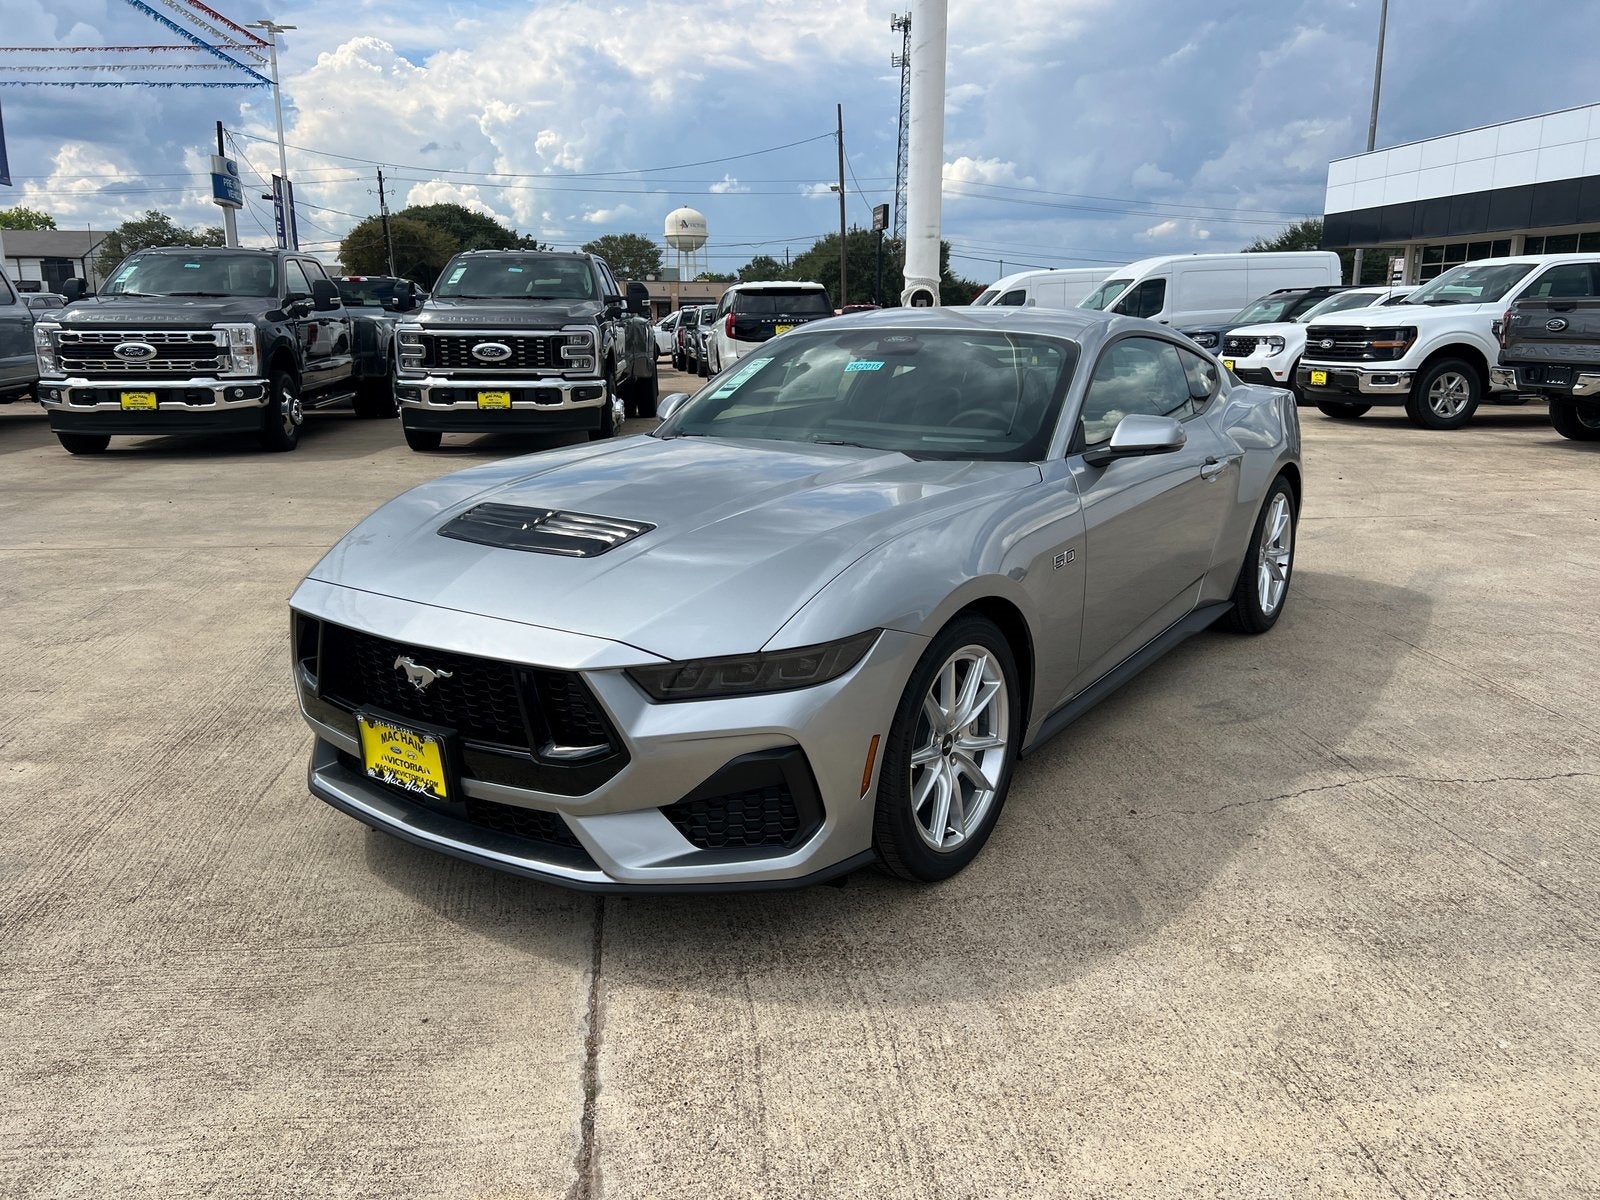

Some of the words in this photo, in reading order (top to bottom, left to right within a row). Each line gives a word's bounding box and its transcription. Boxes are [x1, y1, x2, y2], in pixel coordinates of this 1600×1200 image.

[124, 347, 146, 356] Ford
[481, 347, 502, 356] Ford
[381, 730, 400, 744] MAC
[401, 733, 425, 757] HAIK
[386, 756, 424, 774] VICTORIA
